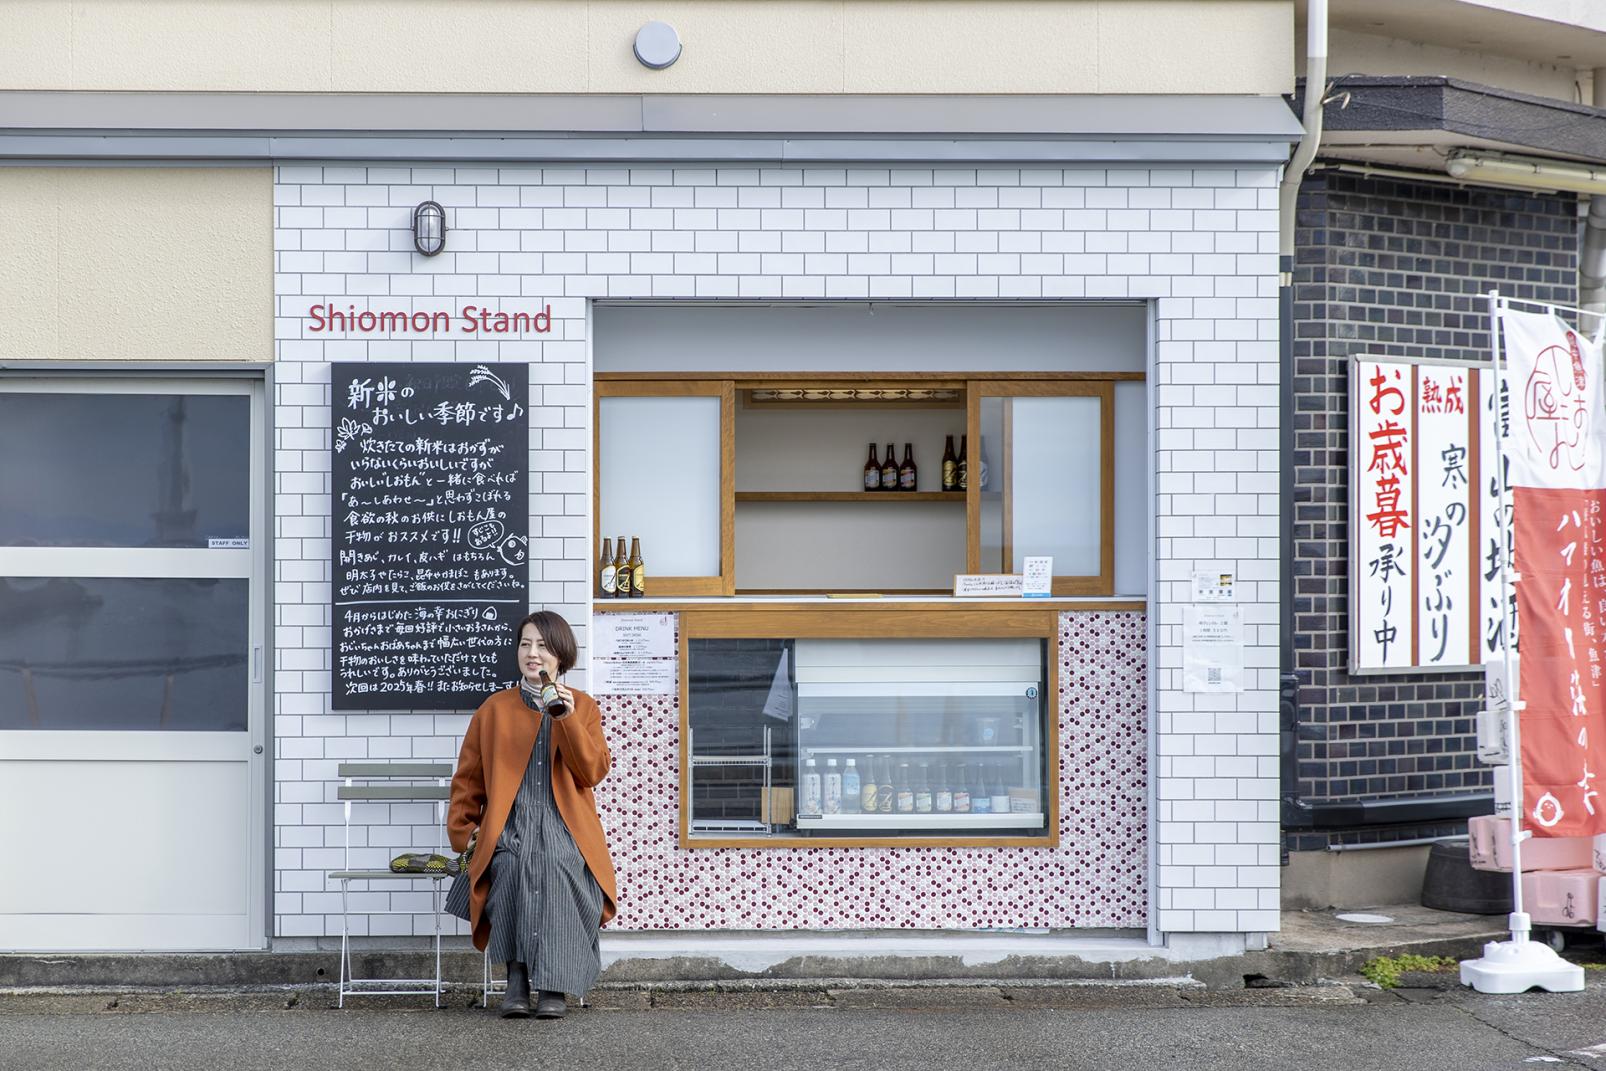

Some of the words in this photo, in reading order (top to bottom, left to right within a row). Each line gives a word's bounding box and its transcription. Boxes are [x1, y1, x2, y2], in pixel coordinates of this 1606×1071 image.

[309, 304, 449, 332] Shiomon
[462, 304, 551, 333] Stand
[348, 376, 414, 410] 新米の
[1421, 376, 1464, 415] 熟成
[360, 437, 504, 456] 炊きたての新米はおかずが
[351, 457, 494, 471] いらないくらいおいしいですが
[343, 507, 507, 526] 食欲の秋のお供にしおもん屋の
[1366, 365, 1411, 664] お歳暮承り中
[344, 606, 480, 624] 4月からはじめた海の幸おにぎり
